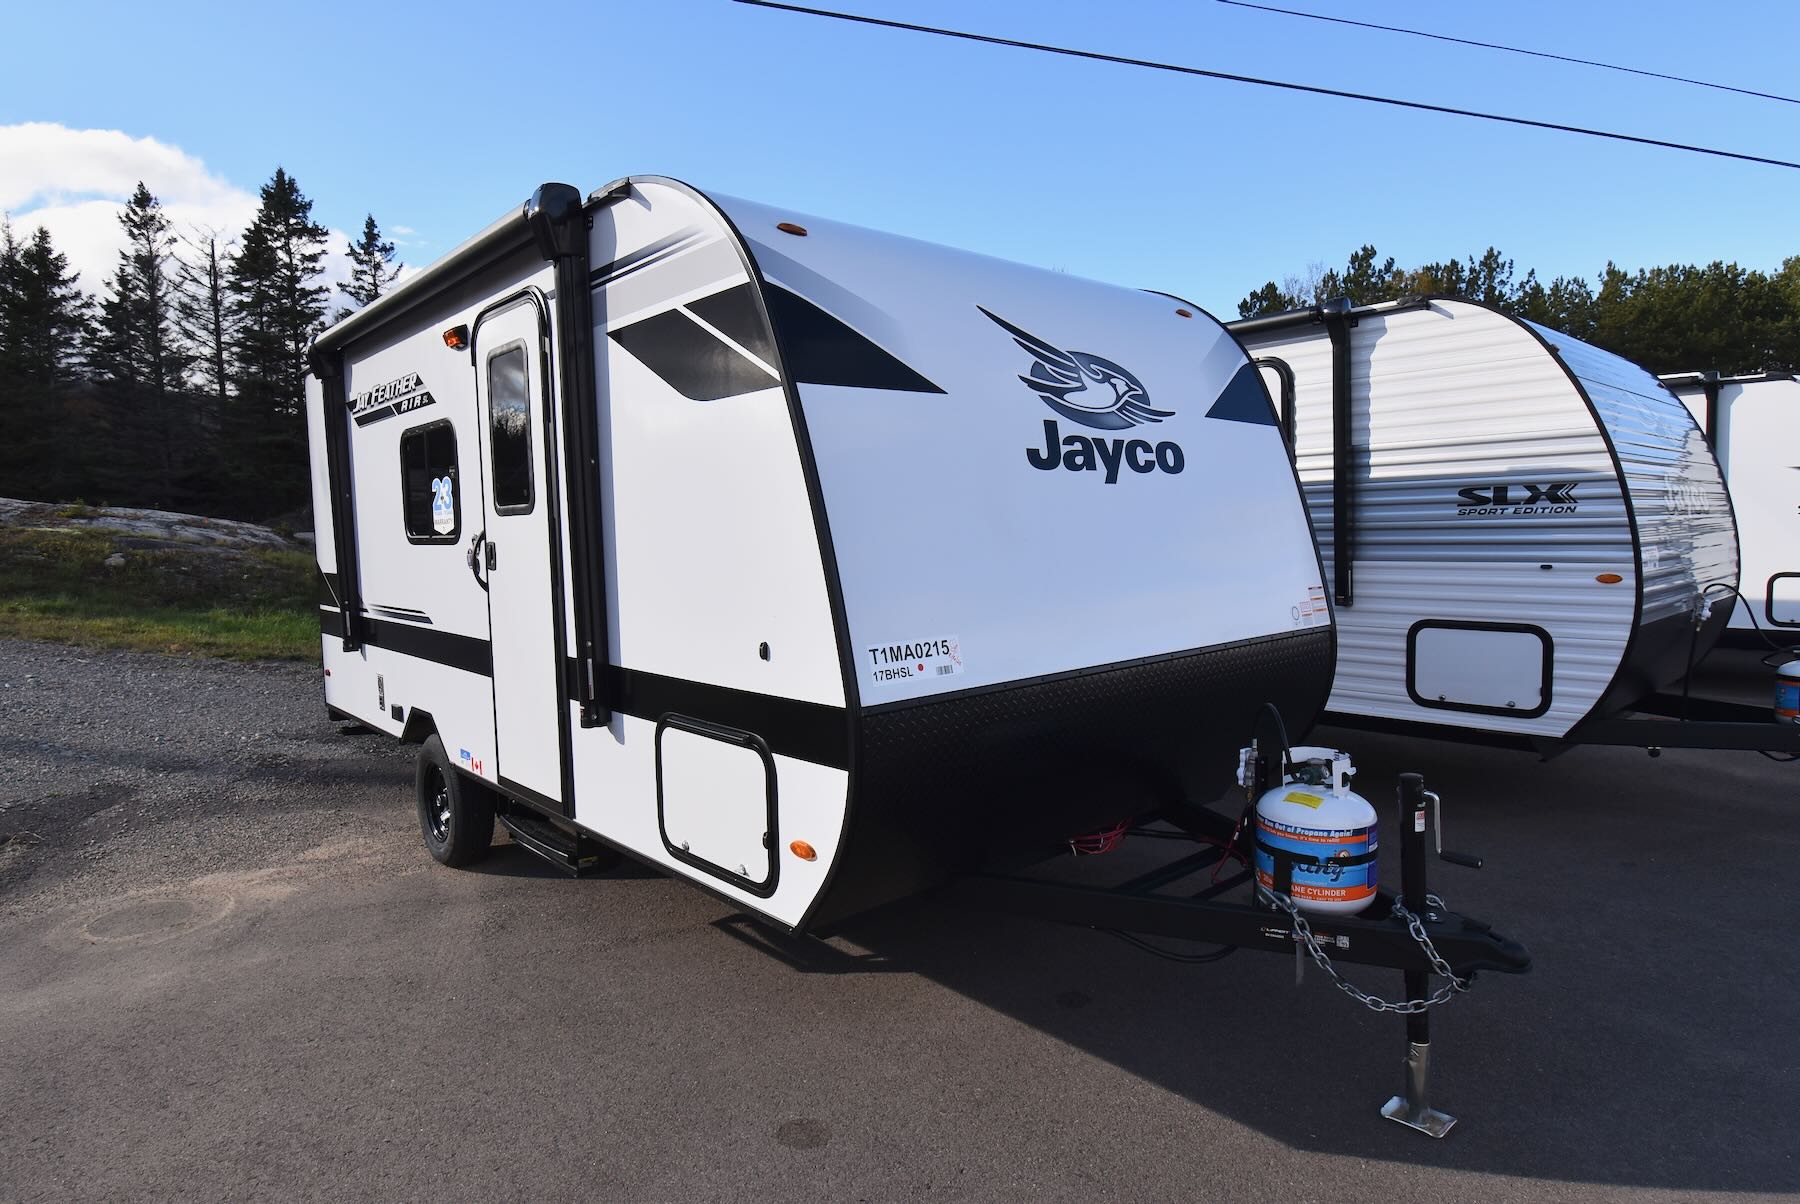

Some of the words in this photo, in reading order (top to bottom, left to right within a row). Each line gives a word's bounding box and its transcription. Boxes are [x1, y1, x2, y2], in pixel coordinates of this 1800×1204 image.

[353, 391, 371, 413] JAY
[370, 373, 417, 406] FEATHER
[400, 395, 421, 412] AIR
[1026, 419, 1185, 484] Jayco
[1456, 482, 1578, 507] SLX
[1456, 507, 1509, 516] SPORT
[1513, 506, 1577, 515] EDITION
[868, 639, 950, 665] T1MA0215
[872, 666, 914, 682] 17BHSL
[1275, 823, 1286, 832] Out
[1286, 825, 1295, 834] of
[1296, 828, 1328, 838] Propane
[1329, 827, 1354, 838] Again!
[1307, 888, 1347, 897] CYLINDER
